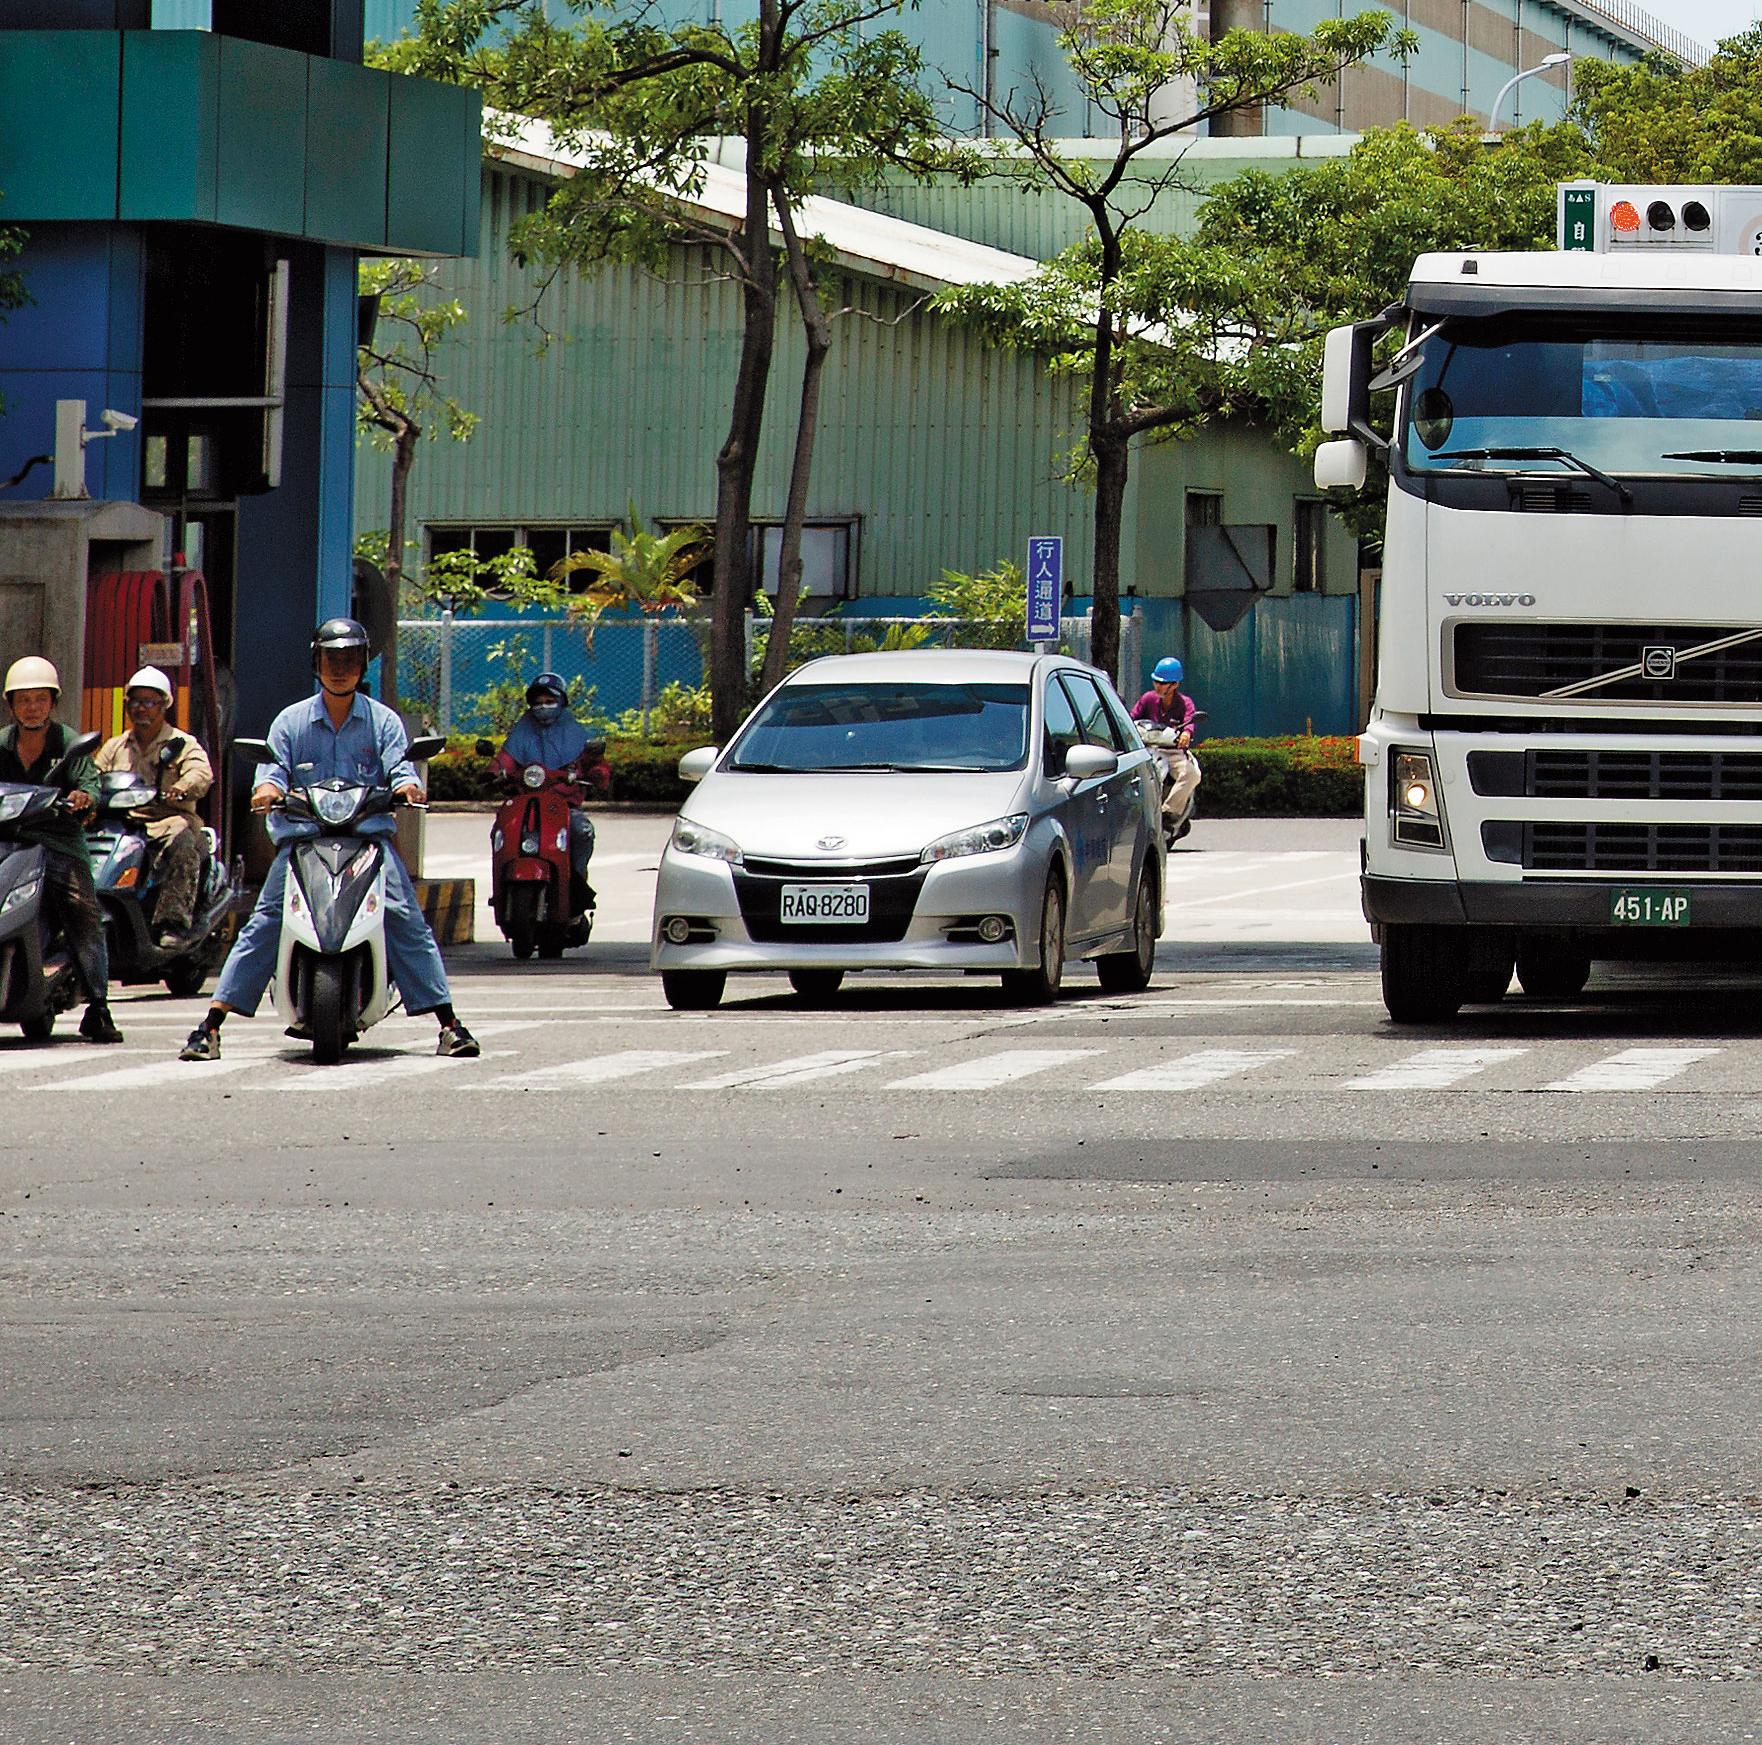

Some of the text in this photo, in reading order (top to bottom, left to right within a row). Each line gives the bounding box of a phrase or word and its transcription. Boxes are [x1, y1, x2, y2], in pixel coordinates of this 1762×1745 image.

[1570, 221, 1586, 252] 自
[1034, 541, 1055, 621] 行人通道
[1443, 591, 1536, 607] VOLVO
[782, 894, 868, 917] RAQ-8280
[1613, 896, 1688, 921] 451-AP
